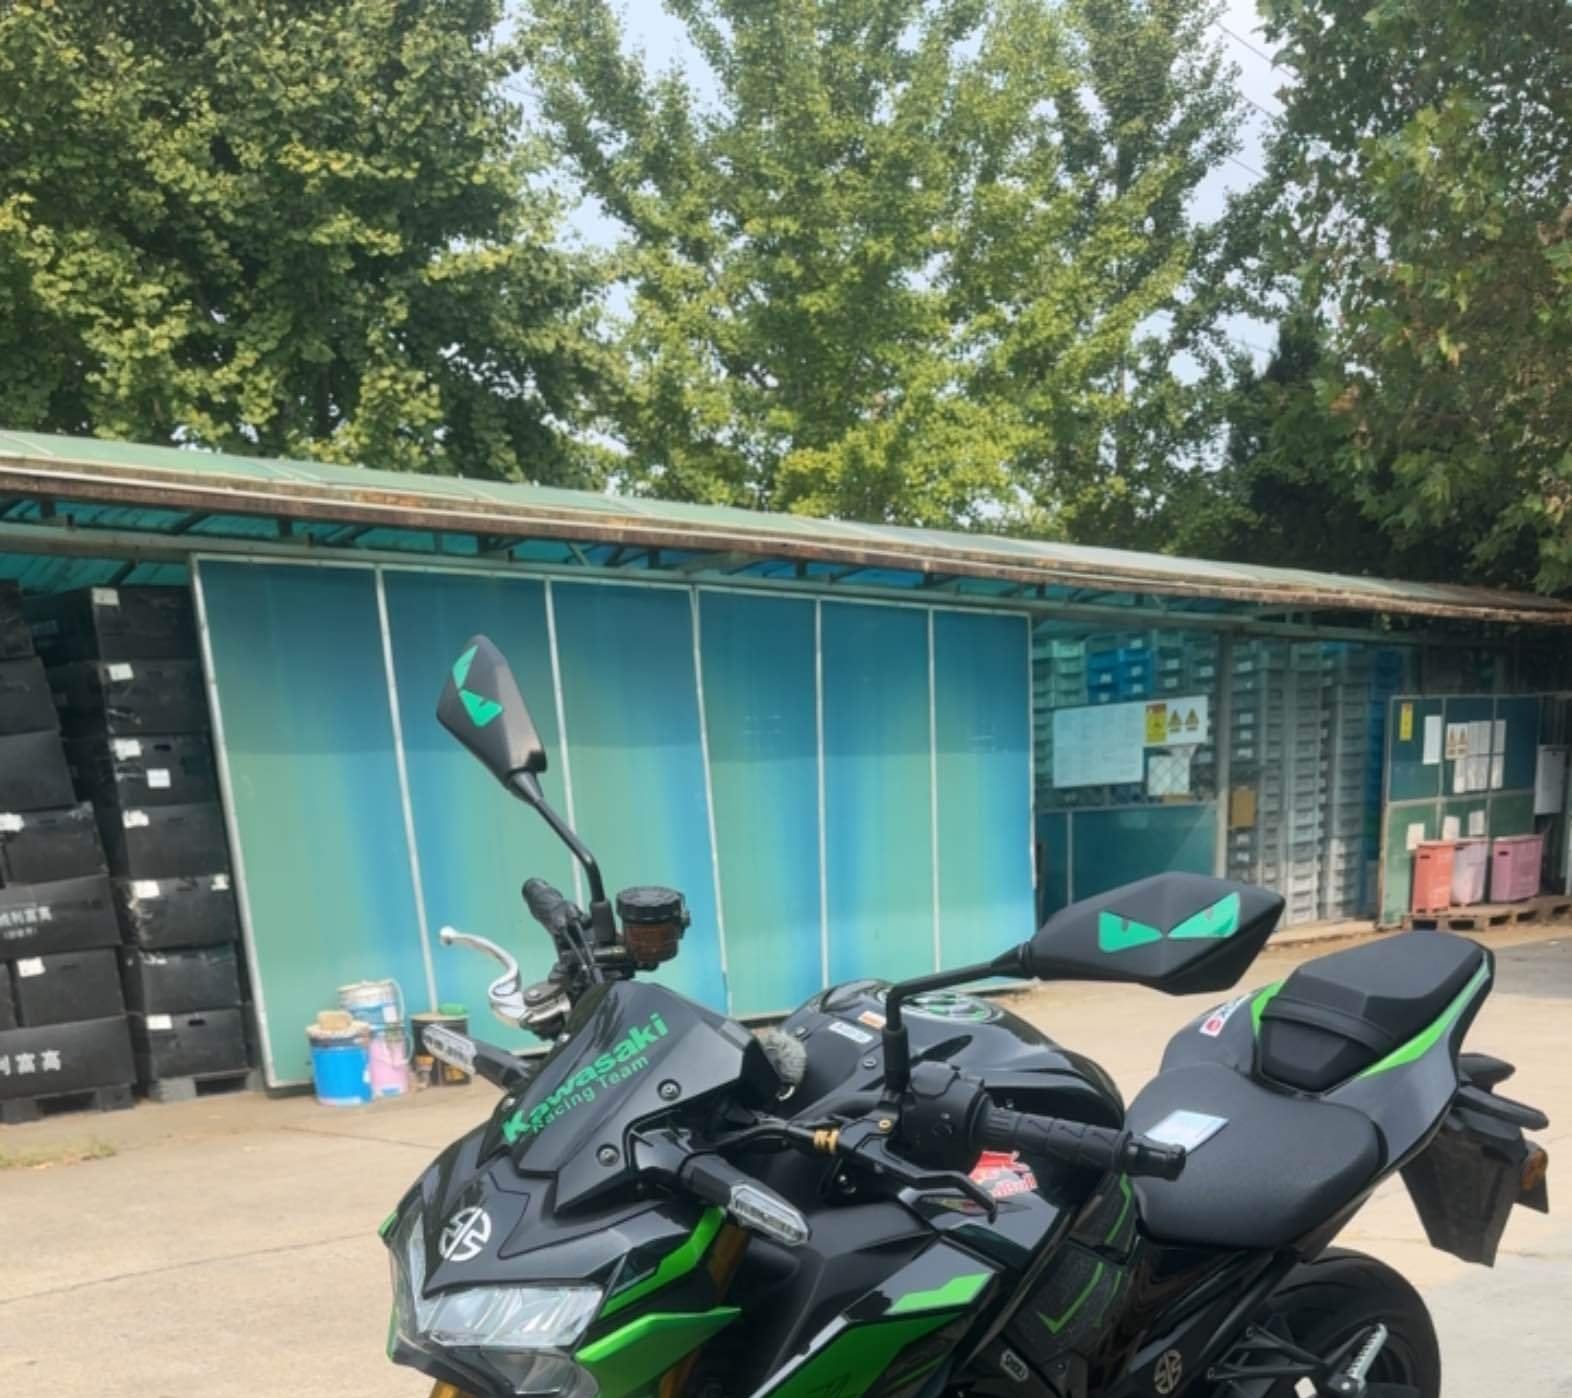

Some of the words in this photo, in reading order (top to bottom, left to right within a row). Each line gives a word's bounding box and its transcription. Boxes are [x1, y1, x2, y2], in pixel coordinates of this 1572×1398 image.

[502, 1012, 669, 1143] Kawasaki
[531, 1086, 596, 1133] Racing
[599, 1055, 649, 1089] Team
